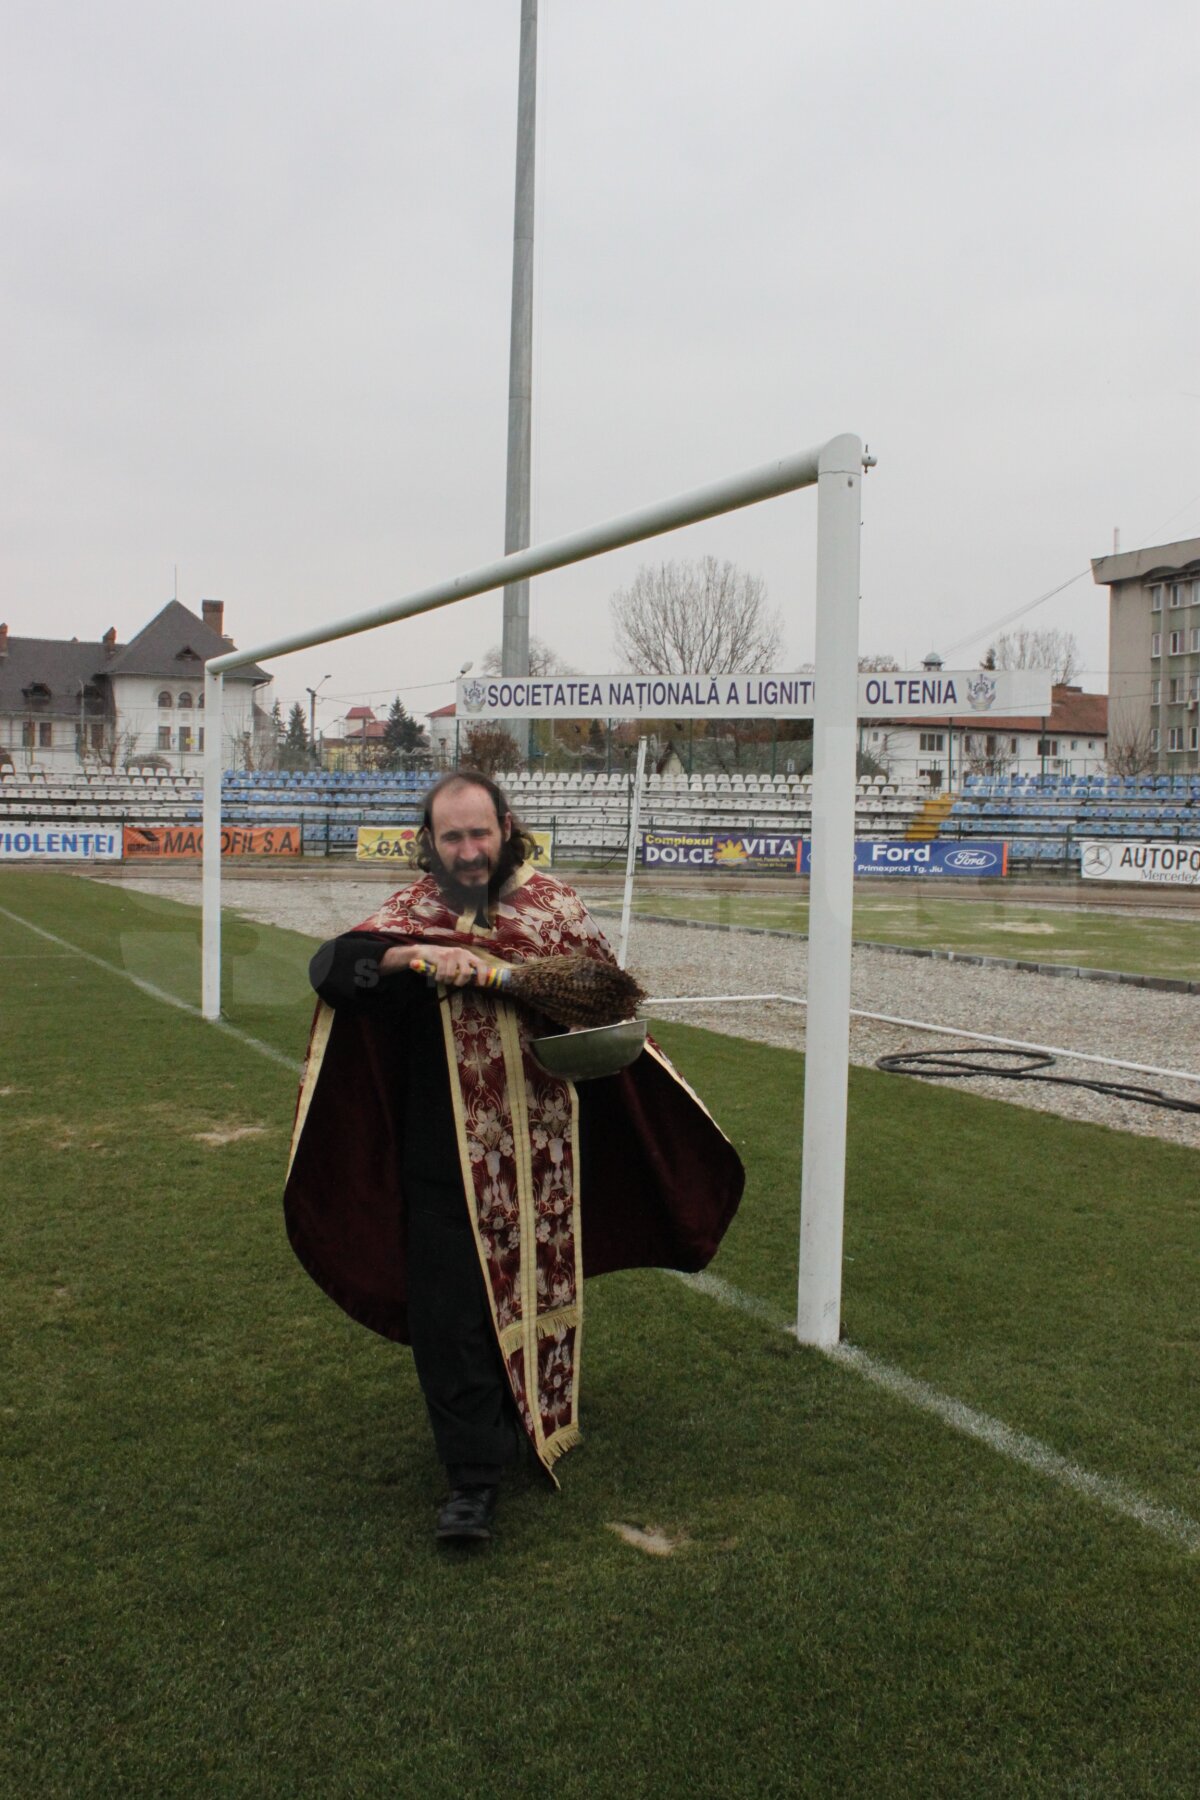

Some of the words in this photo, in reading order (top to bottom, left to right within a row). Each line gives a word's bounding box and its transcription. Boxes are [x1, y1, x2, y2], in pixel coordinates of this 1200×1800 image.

[487, 683, 603, 707] SOCIETATEA
[726, 682, 740, 705] A
[746, 681, 815, 705] LIGNIT
[866, 680, 957, 704] OLTENIA
[0, 833, 114, 857] IOLENȚEI
[645, 834, 714, 847] Complexul
[646, 847, 714, 863] DOLCE
[742, 838, 795, 855] VITA
[872, 844, 931, 862] Ford
[953, 851, 987, 866] Ford
[857, 864, 911, 873] Primexprod
[913, 864, 927, 873] Tg.
[929, 865, 943, 873] Jiu
